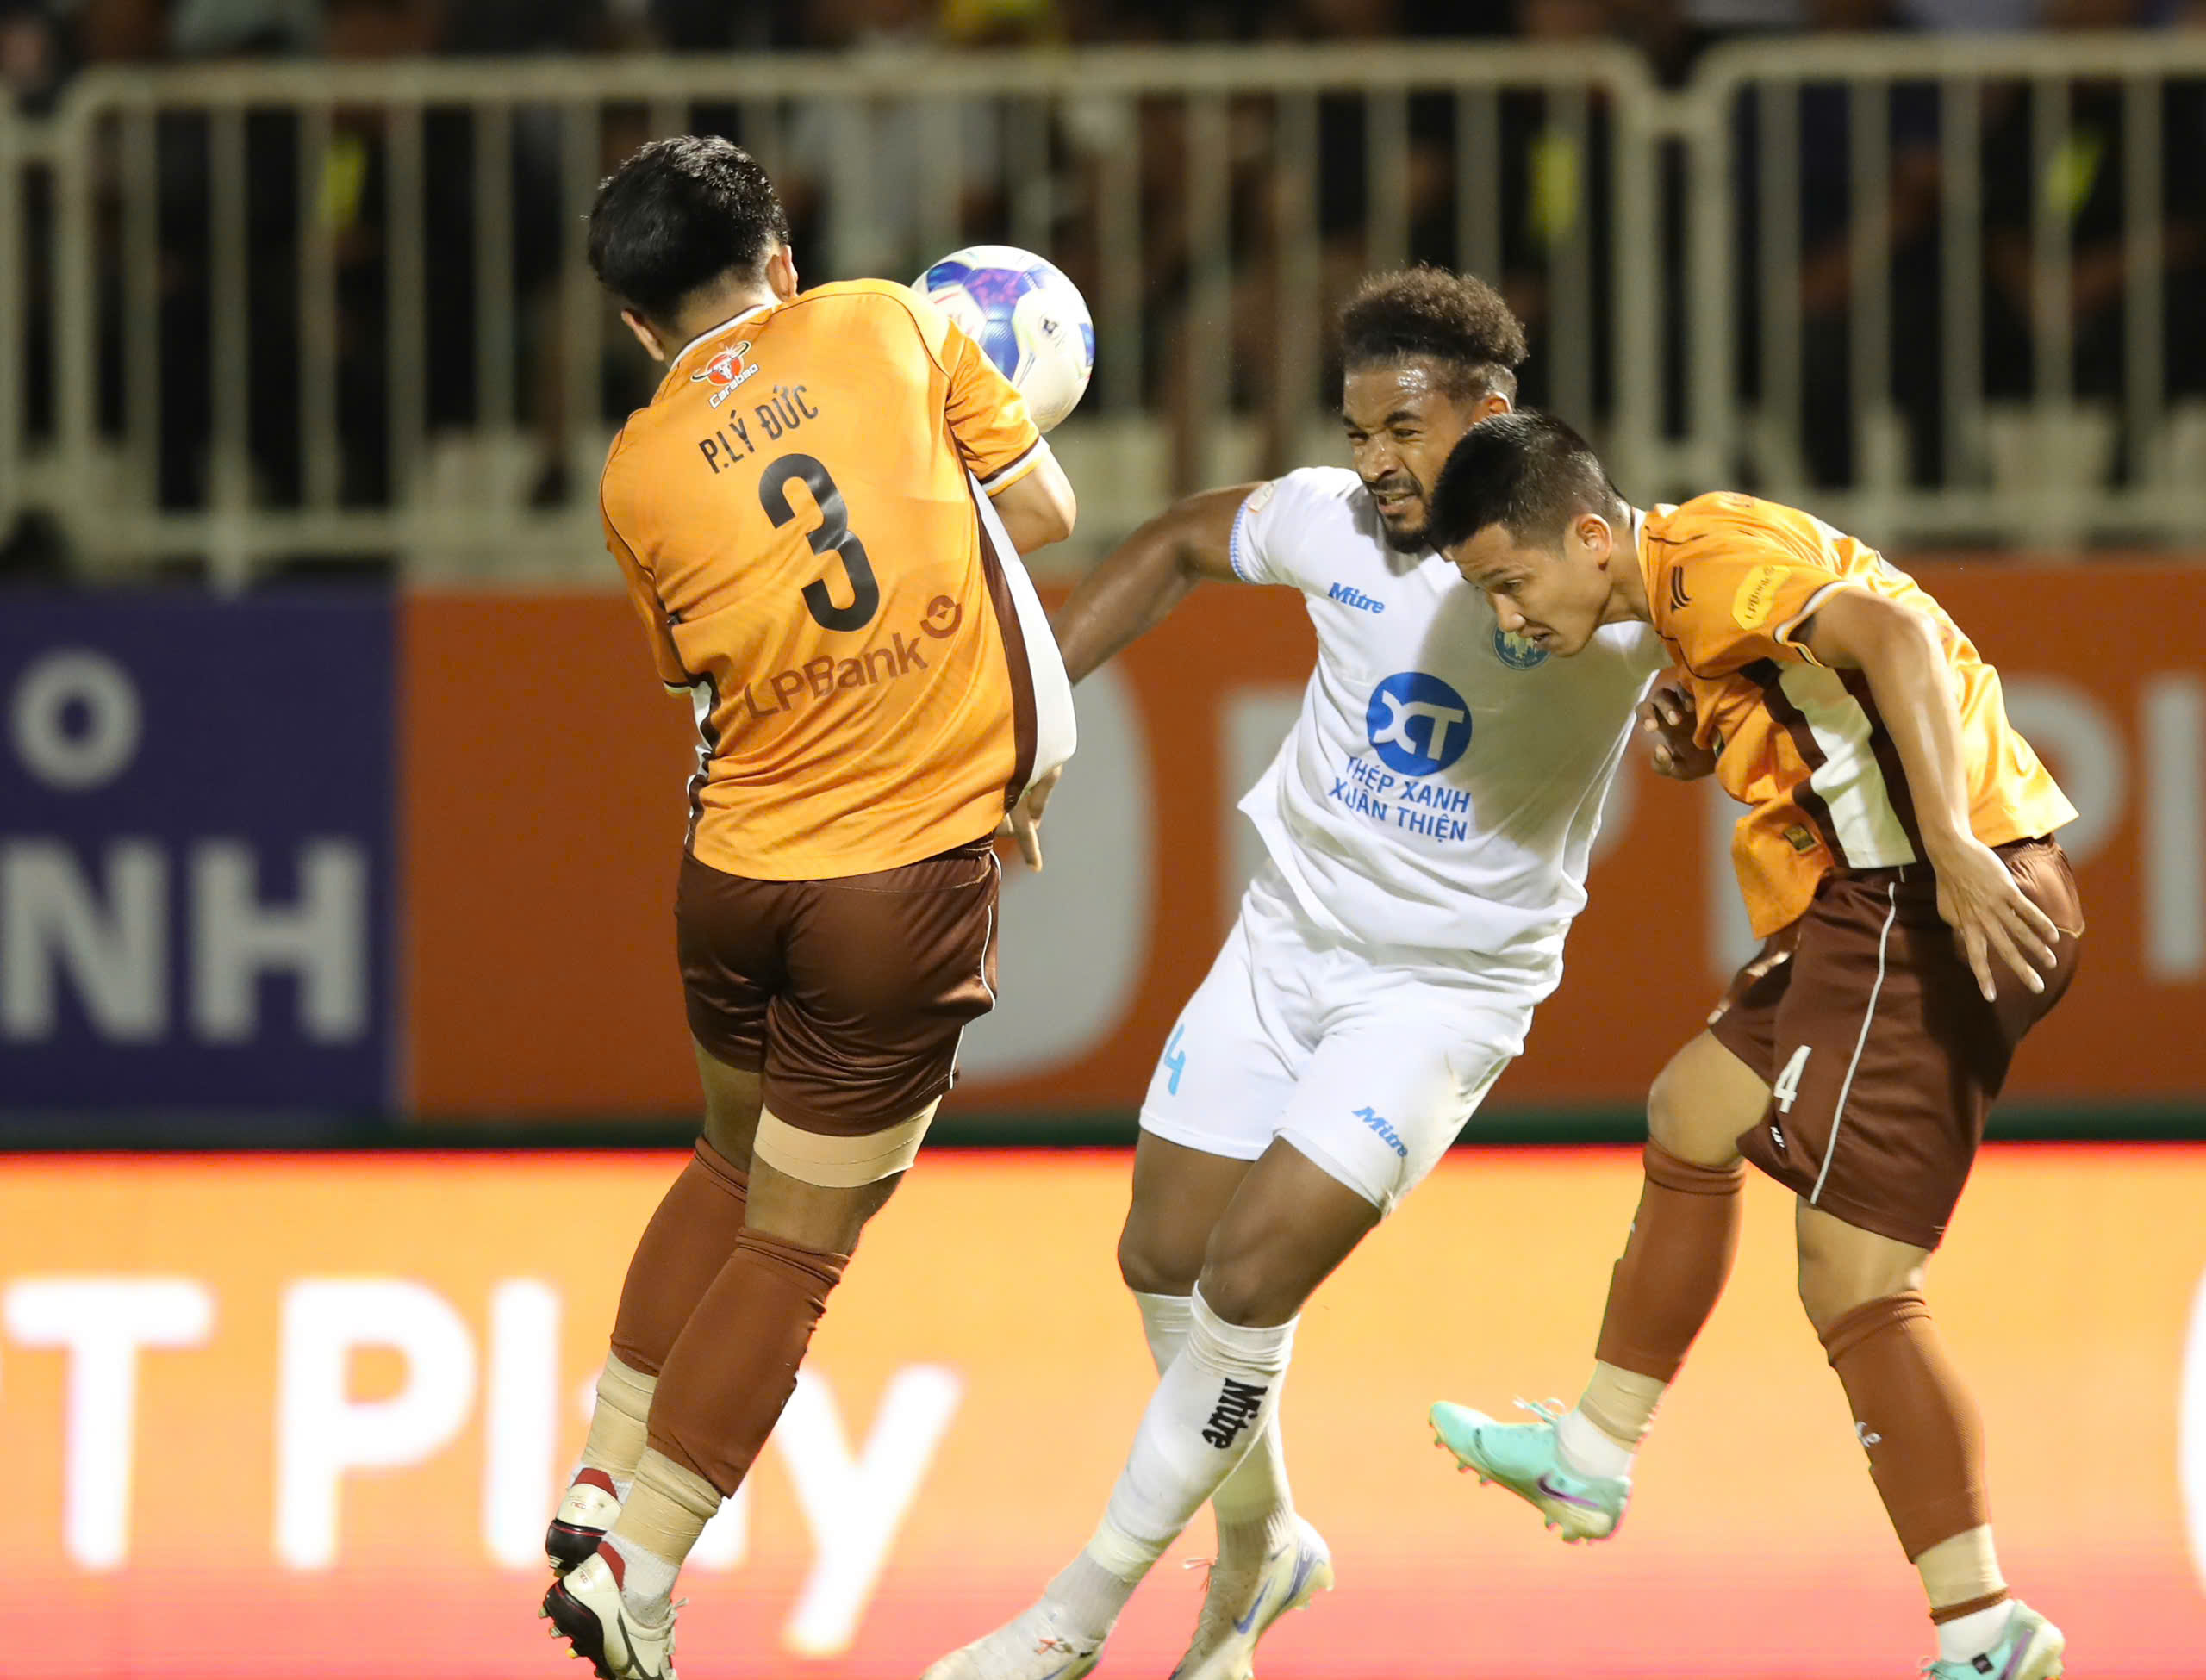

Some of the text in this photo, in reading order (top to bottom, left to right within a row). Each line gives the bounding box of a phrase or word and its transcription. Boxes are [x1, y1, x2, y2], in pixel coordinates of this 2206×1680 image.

[708, 363, 759, 409] Carabao
[698, 385, 819, 474] P.LÝ ĐỨC
[758, 453, 880, 632] 3
[1328, 582, 1385, 613] Mitre
[745, 632, 928, 719] LPBank
[1328, 776, 1468, 843] XUÂN THIỆN
[1346, 756, 1471, 814] THÉP XANH
[0, 838, 367, 1044] NH
[1163, 1023, 1187, 1096] 4
[1773, 1044, 1812, 1114] 4
[1351, 1106, 1408, 1158] Mitre
[1202, 1378, 1268, 1450] Mitre
[3, 1277, 963, 1654] T Ply
